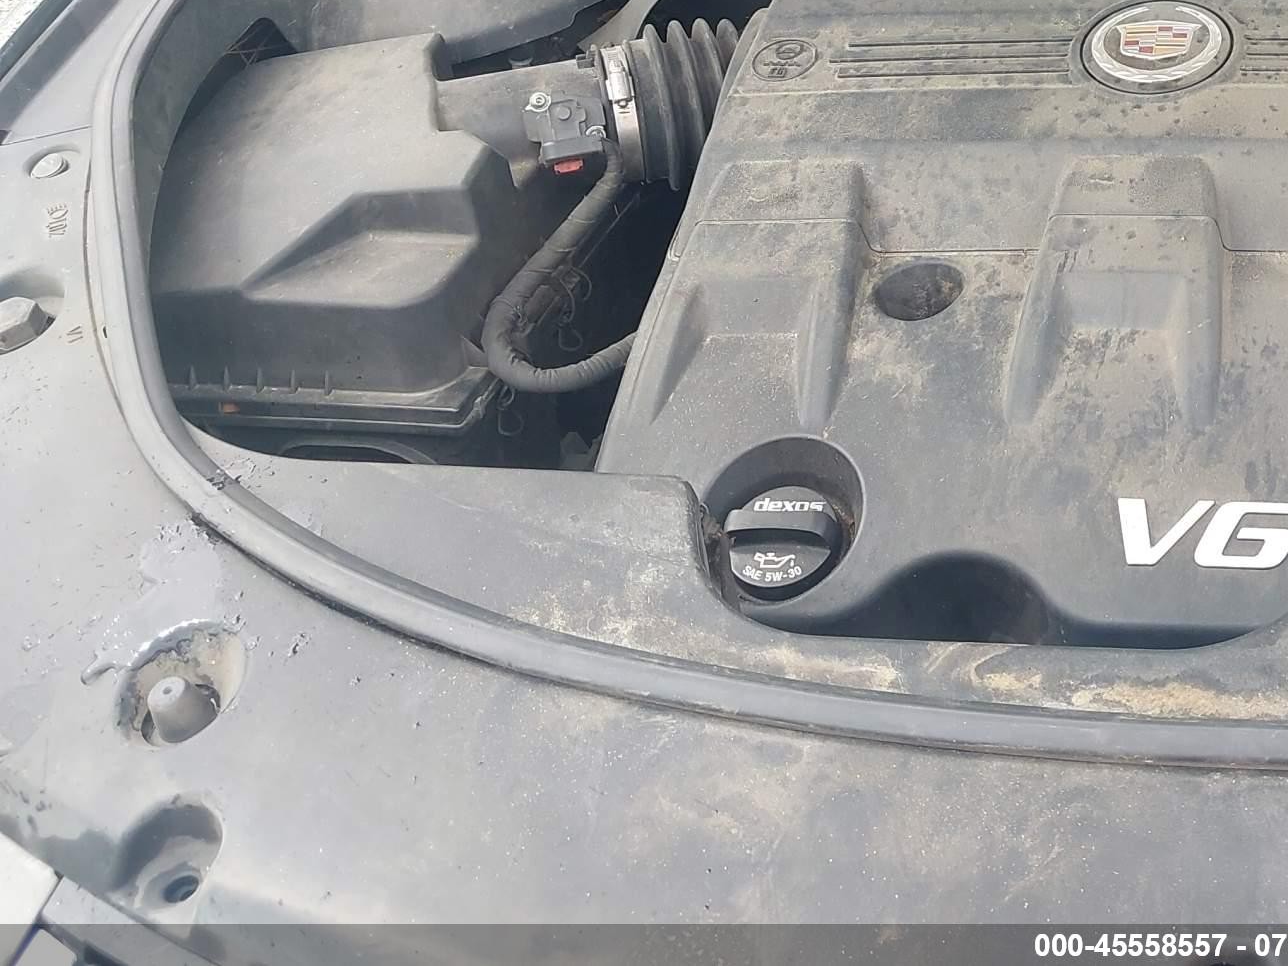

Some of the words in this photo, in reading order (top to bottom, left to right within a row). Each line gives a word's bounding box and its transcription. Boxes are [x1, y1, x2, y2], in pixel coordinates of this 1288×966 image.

[753, 497, 826, 512] dexos
[742, 566, 763, 581] SAE
[764, 565, 802, 582] 5W-30
